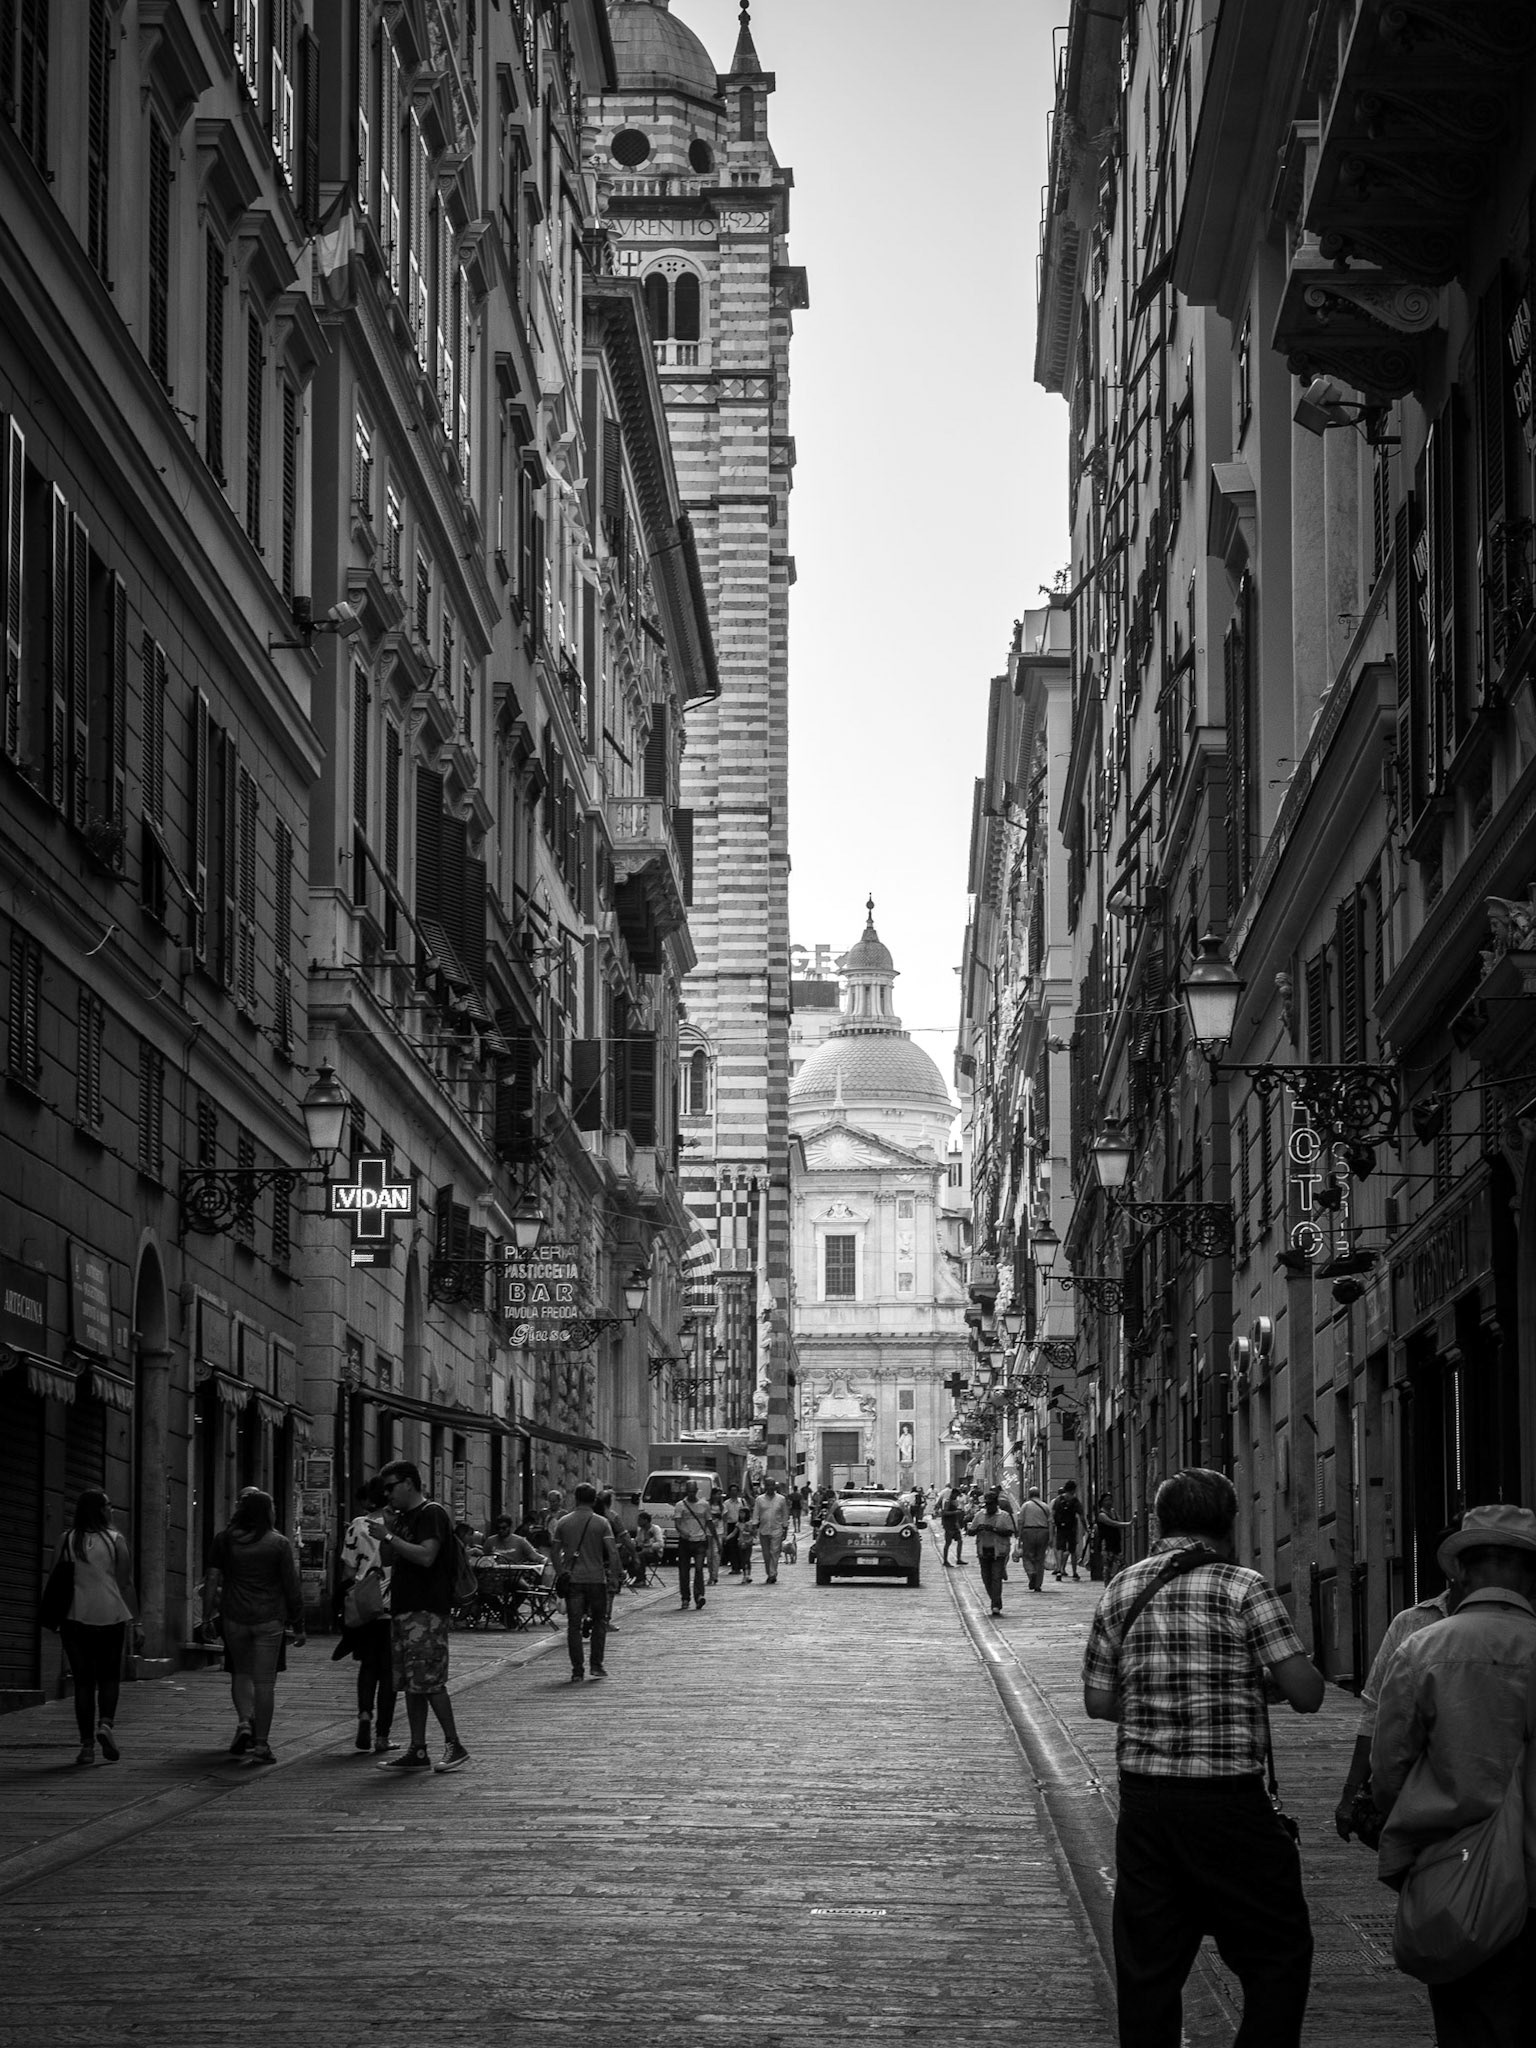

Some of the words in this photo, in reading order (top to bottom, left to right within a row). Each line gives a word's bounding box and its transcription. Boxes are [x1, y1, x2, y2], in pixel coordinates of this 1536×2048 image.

[509, 1282, 573, 1302] BAR
[504, 1306, 539, 1319] TAVOLA
[847, 1538, 887, 1546] POLIZIA
